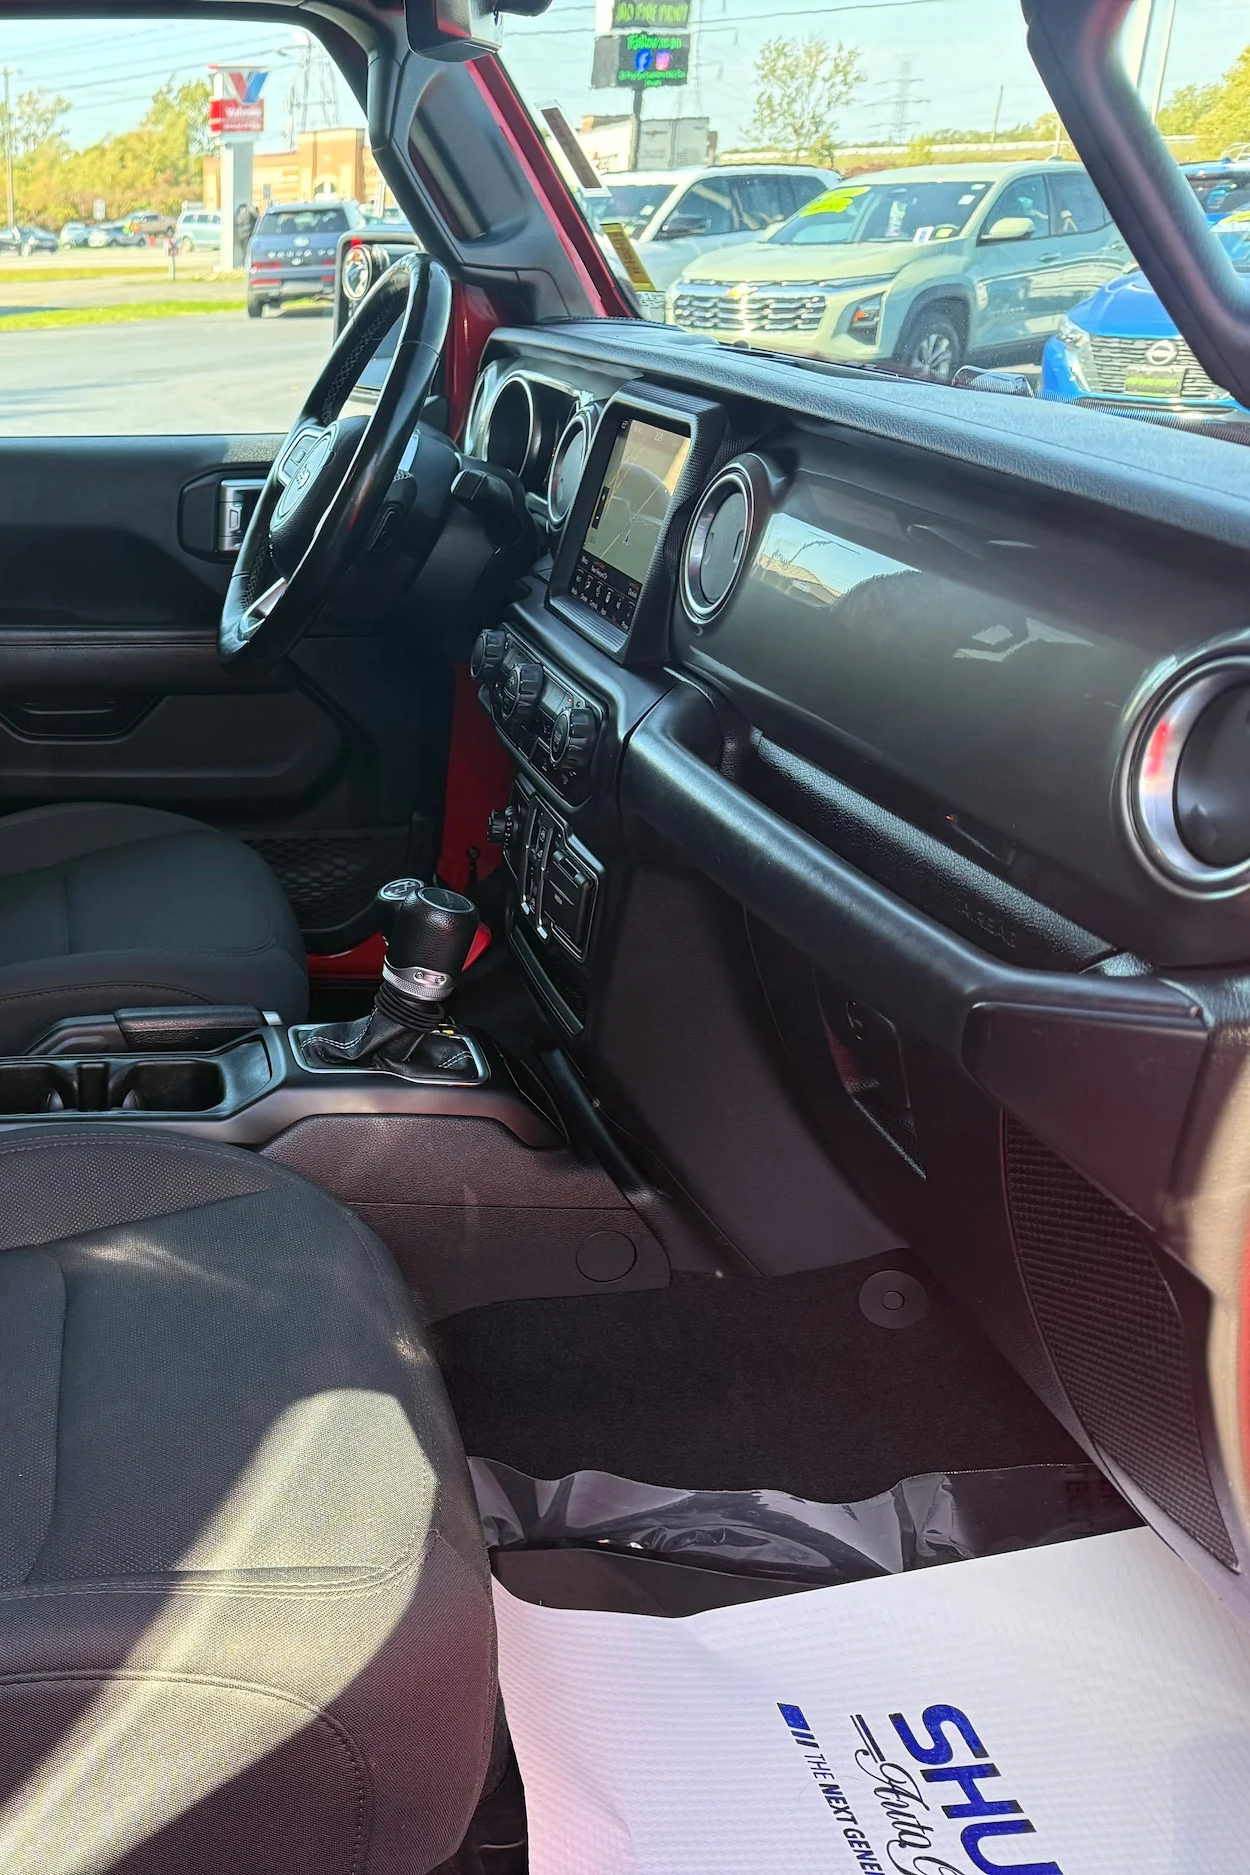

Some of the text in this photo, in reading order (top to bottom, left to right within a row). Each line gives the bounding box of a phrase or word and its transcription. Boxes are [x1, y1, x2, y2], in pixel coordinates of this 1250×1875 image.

[804, 1753, 886, 1875] THE NEXT GENE
[888, 1703, 1064, 1875] SHU
